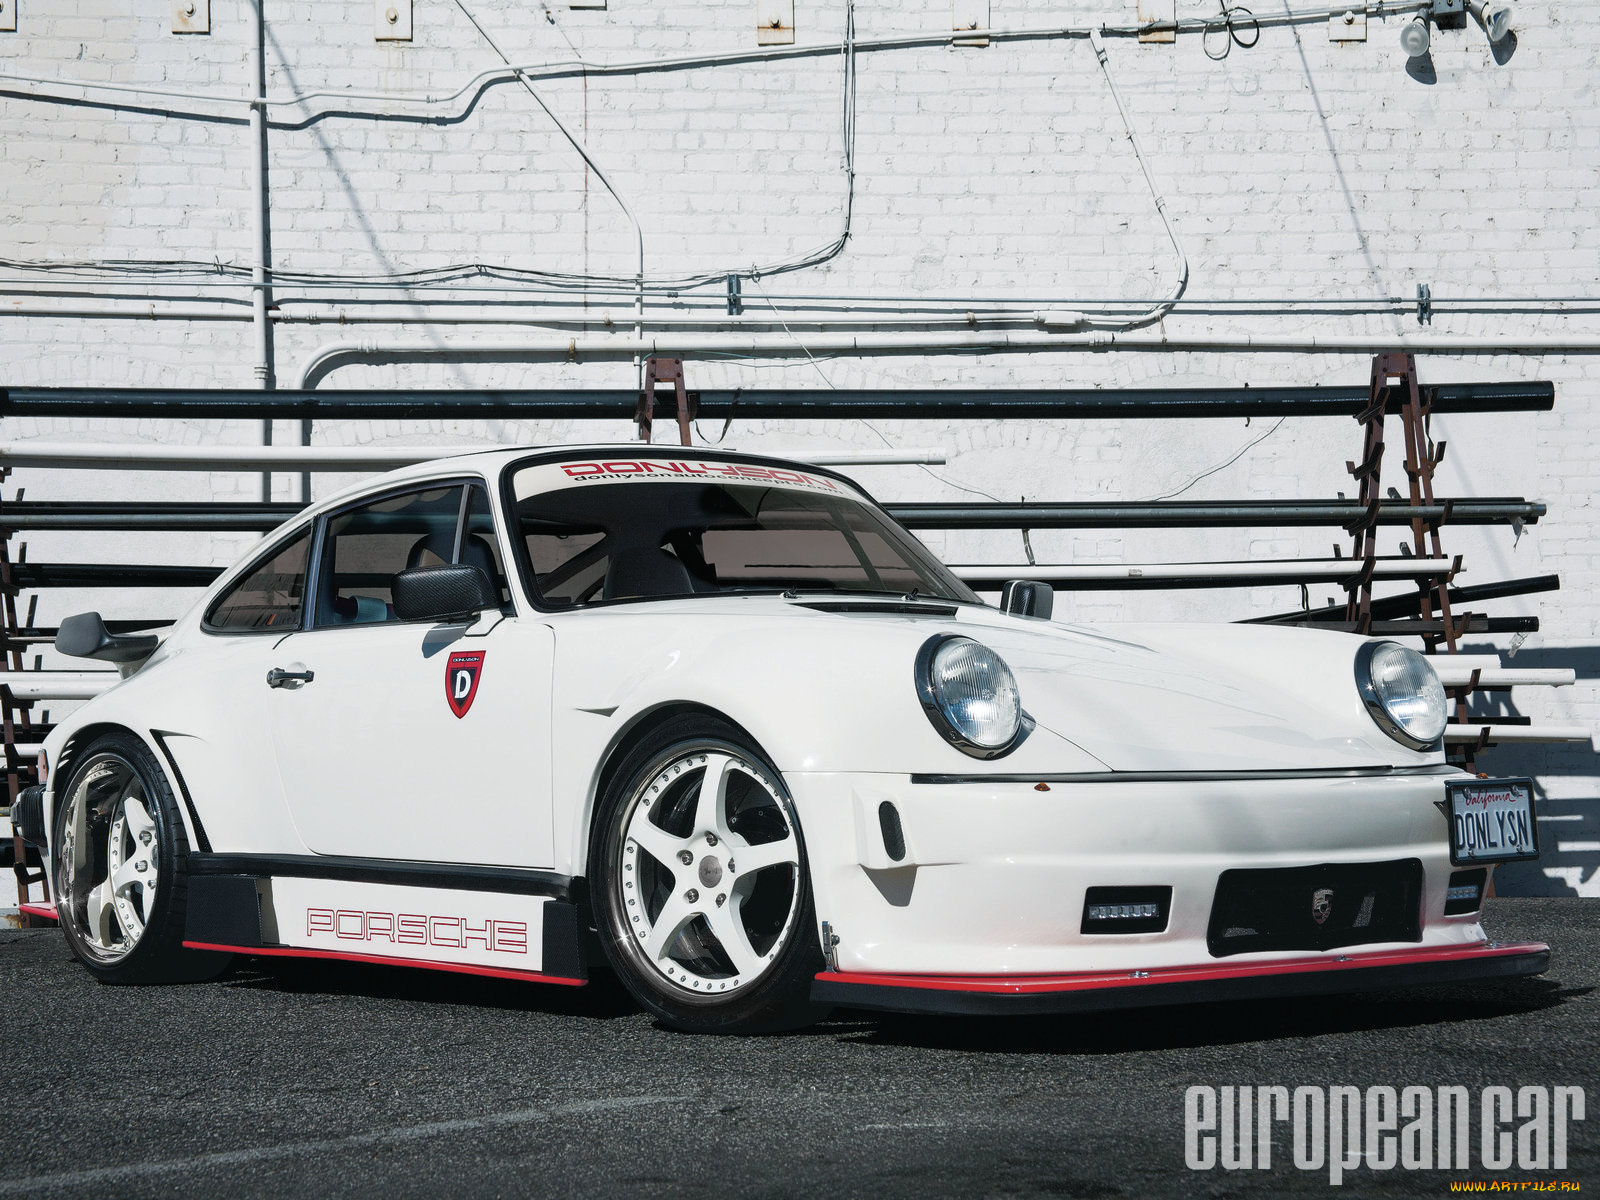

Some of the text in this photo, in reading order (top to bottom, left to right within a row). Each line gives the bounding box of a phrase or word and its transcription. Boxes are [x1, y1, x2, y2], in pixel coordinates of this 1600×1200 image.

[560, 462, 836, 489] DONLYSON
[574, 473, 843, 494] donlysonautoconcepts.com
[455, 670, 471, 698] D
[1455, 810, 1528, 849] DONLYSN
[307, 908, 527, 954] PORSCHE
